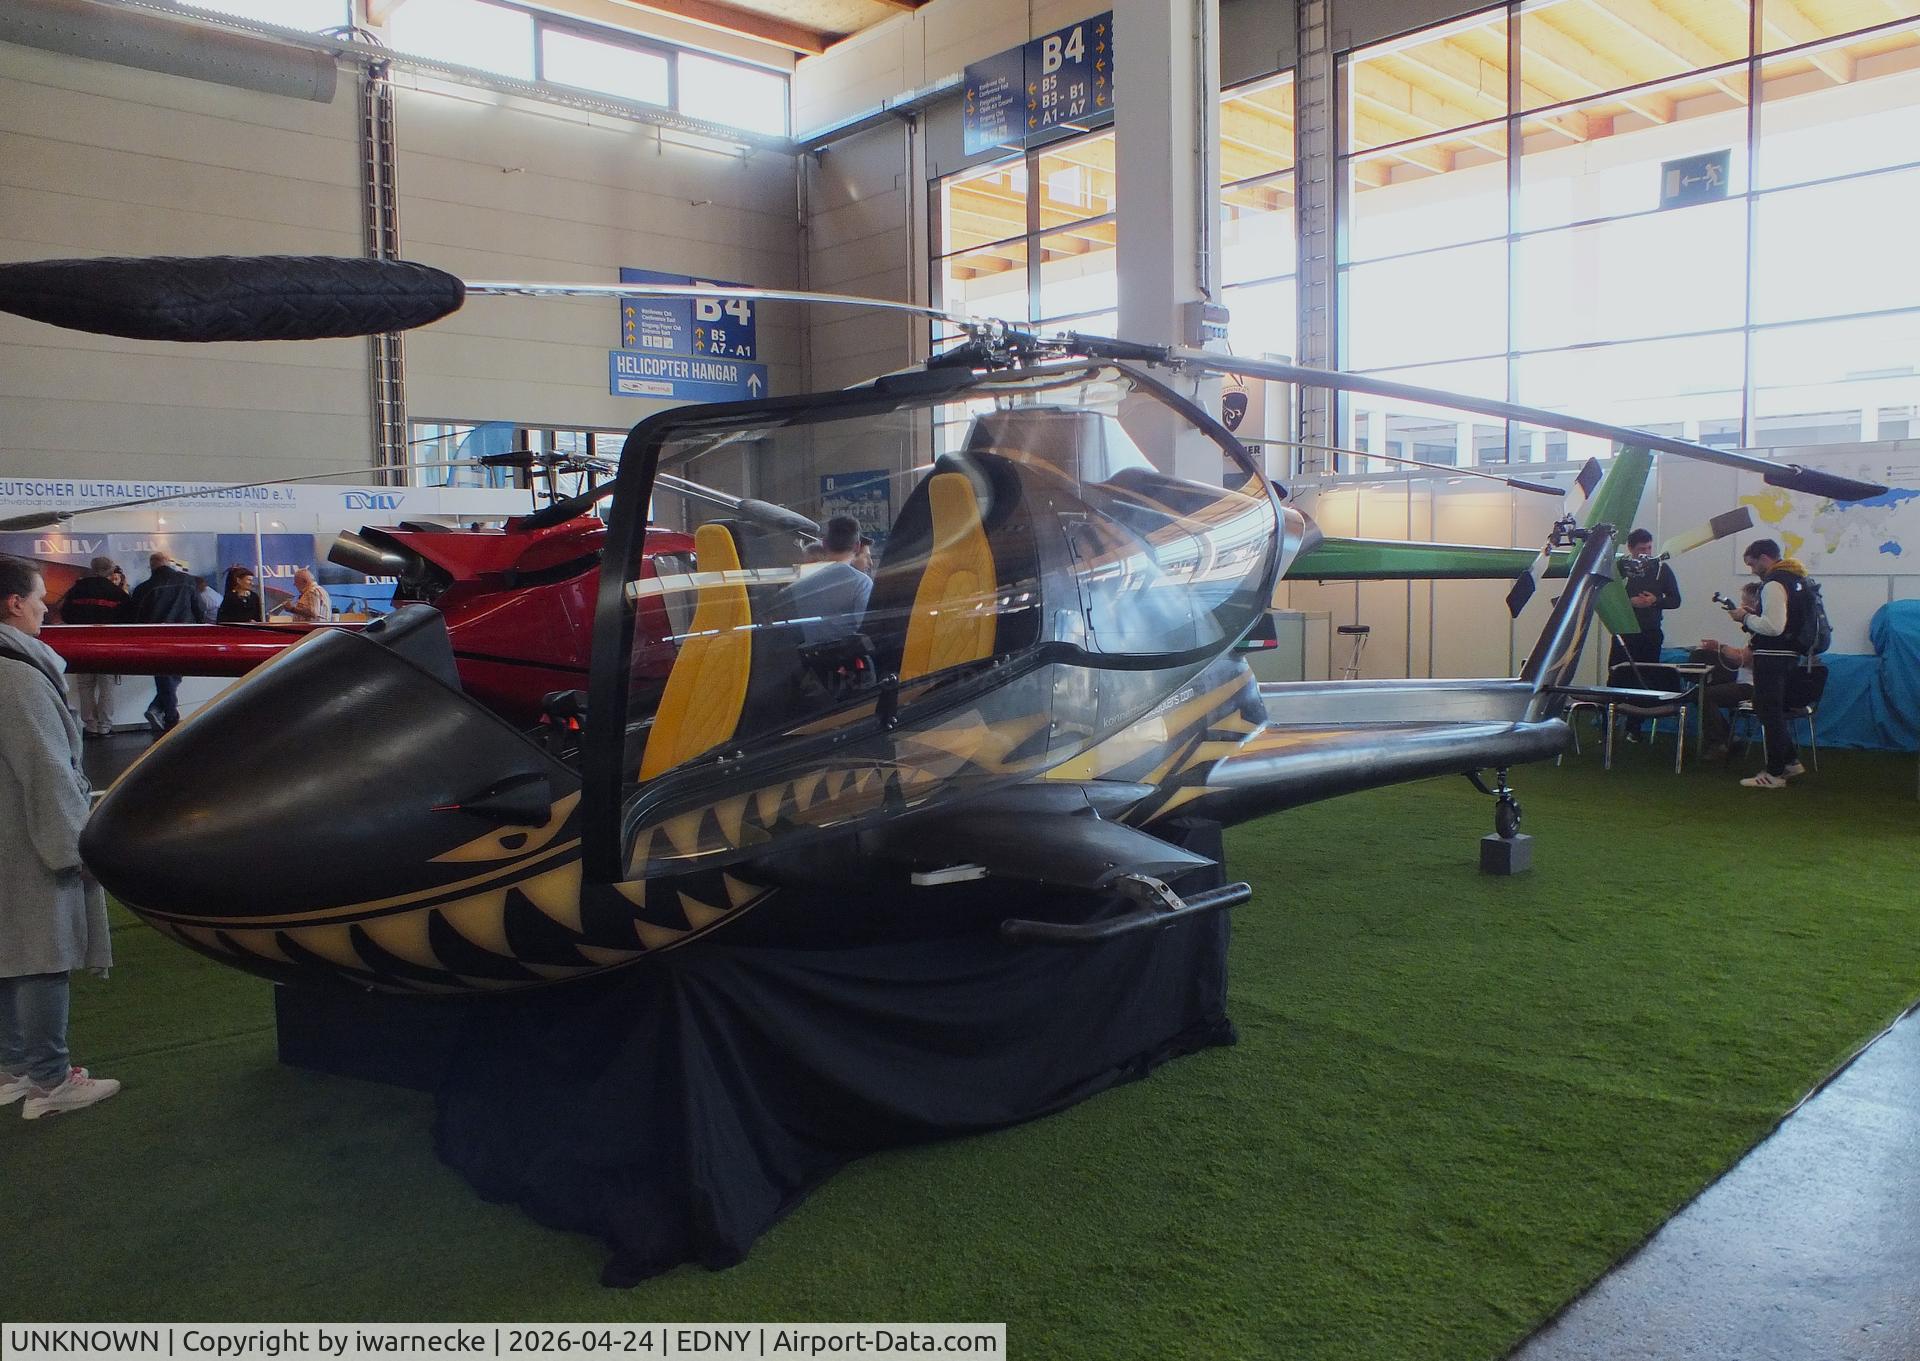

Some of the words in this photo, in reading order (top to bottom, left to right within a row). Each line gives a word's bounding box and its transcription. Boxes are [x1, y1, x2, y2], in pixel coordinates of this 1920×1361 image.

[1042, 26, 1085, 75] B4
[1042, 75, 1057, 92] B5
[1042, 91, 1057, 109] B3
[1070, 82, 1084, 98] B1
[1042, 109, 1058, 125] A1
[1069, 99, 1086, 116] A7
[696, 281, 751, 326] B4
[711, 329, 726, 341] B5
[710, 343, 725, 355] A7
[736, 345, 751, 357] A1
[617, 356, 689, 378] HELICOPTER
[692, 362, 738, 382] HANGAR
[80, 484, 269, 501] ULTRALEICHTFLUGVERBAND
[273, 489, 283, 500] e.
[286, 488, 297, 500] V.
